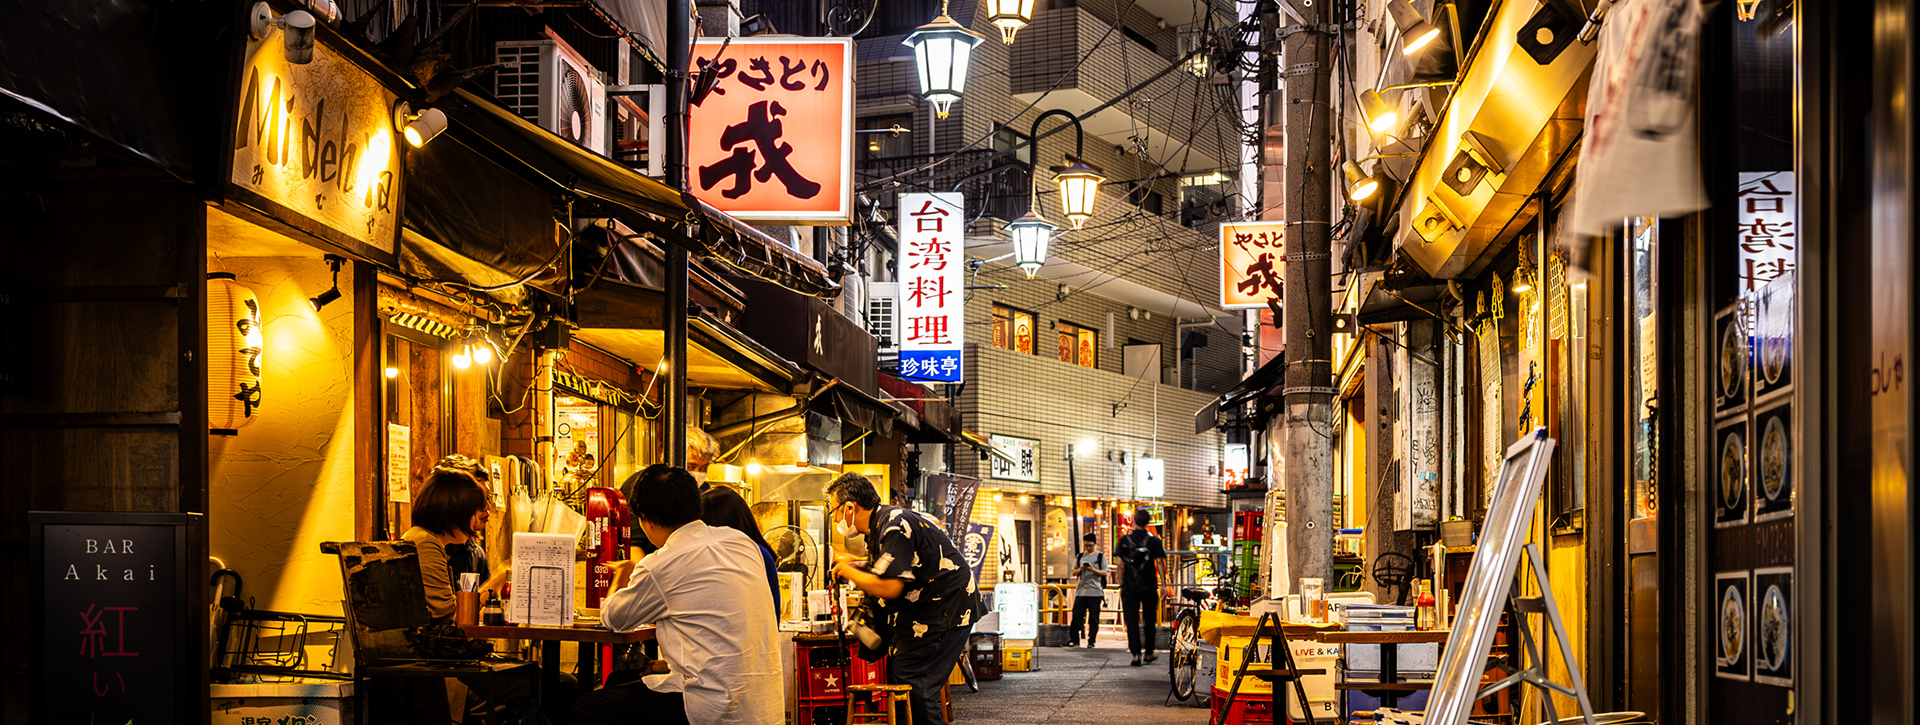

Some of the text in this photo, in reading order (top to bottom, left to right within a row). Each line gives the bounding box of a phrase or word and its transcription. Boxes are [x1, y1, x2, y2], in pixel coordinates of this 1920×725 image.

[698, 99, 822, 200] 戎
[906, 200, 953, 346] 台湾料理
[900, 355, 959, 377] 珍味亭
[85, 539, 134, 554] BAR
[64, 563, 155, 581] Akai
[594, 579, 609, 588] 2111
[1295, 648, 1315, 656] LIVE
[1317, 648, 1324, 656] &
